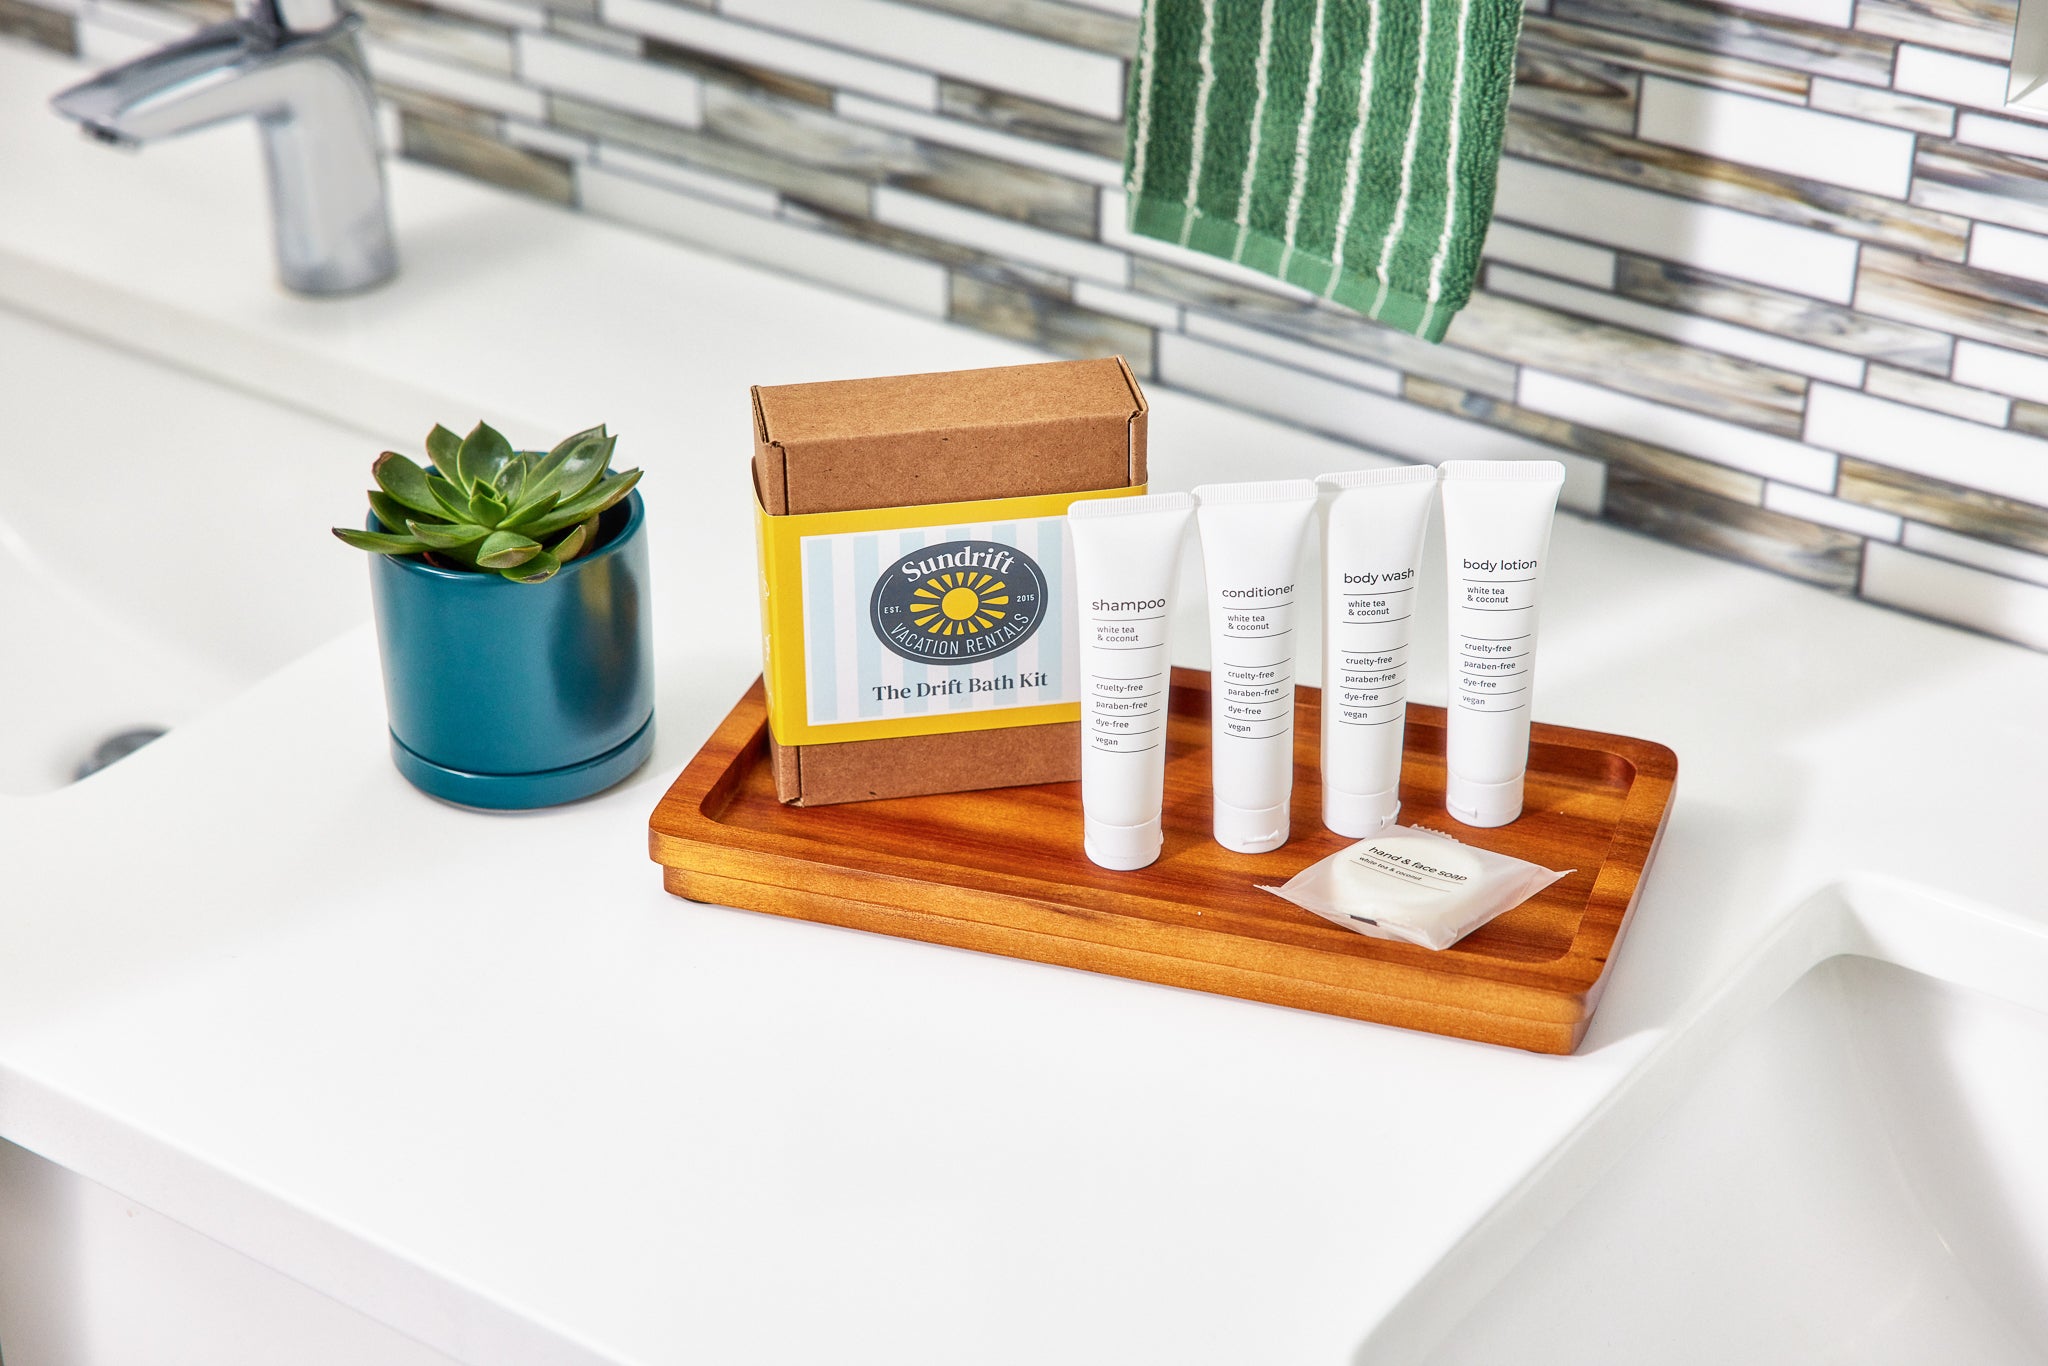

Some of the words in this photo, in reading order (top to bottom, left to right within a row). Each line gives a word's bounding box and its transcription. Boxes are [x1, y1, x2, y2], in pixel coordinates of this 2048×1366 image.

[902, 546, 1015, 582] Sundrift
[1463, 558, 1497, 573] body
[1500, 559, 1537, 570] lotion
[1344, 573, 1378, 585] body
[1382, 568, 1415, 581] wash
[1222, 584, 1295, 598] conditioner
[1467, 586, 1490, 595] white
[1492, 587, 1505, 595] tea
[884, 606, 902, 614] EST.
[1016, 594, 1035, 603] 2015
[1348, 600, 1371, 608] white
[1476, 595, 1509, 603] coconut
[1092, 598, 1166, 613] shampoo
[1348, 608, 1355, 616] &
[1357, 608, 1390, 616] coconut
[1227, 614, 1250, 622] white
[1252, 614, 1265, 622] tea
[1097, 625, 1120, 634] white
[1122, 626, 1135, 634] tea
[1236, 623, 1270, 631] coconut
[891, 622, 959, 655] VACATION
[967, 613, 1029, 654] RENTALS
[1097, 634, 1103, 642] &
[1106, 634, 1139, 642] coconut
[1464, 642, 1512, 654] cruelty-free
[1346, 656, 1392, 666] cruelty-free
[1464, 660, 1516, 671] paraben-free
[1228, 670, 1275, 681] cruelty-free
[1345, 672, 1396, 684] paraben-free
[872, 684, 912, 702] The
[917, 679, 962, 698] Drift
[969, 675, 1014, 693] Bath
[1019, 671, 1048, 689] Kit
[1096, 682, 1144, 693] cruelty-free
[1463, 677, 1496, 688] dye-free
[1228, 687, 1279, 698] paraben-free
[1344, 692, 1379, 703] dye-free
[1096, 701, 1148, 710] paraben-free
[1462, 696, 1485, 705] vegan
[1228, 705, 1262, 716] dye-free
[1343, 710, 1368, 719] vegan
[1096, 718, 1129, 729] dye-free
[1228, 723, 1251, 733] vegan
[1095, 736, 1119, 746] vegan
[1359, 856, 1377, 865] white
[1395, 870, 1422, 880] coconut
[1368, 846, 1401, 861] hand
[1411, 861, 1437, 873] face
[1437, 871, 1467, 881] soap
